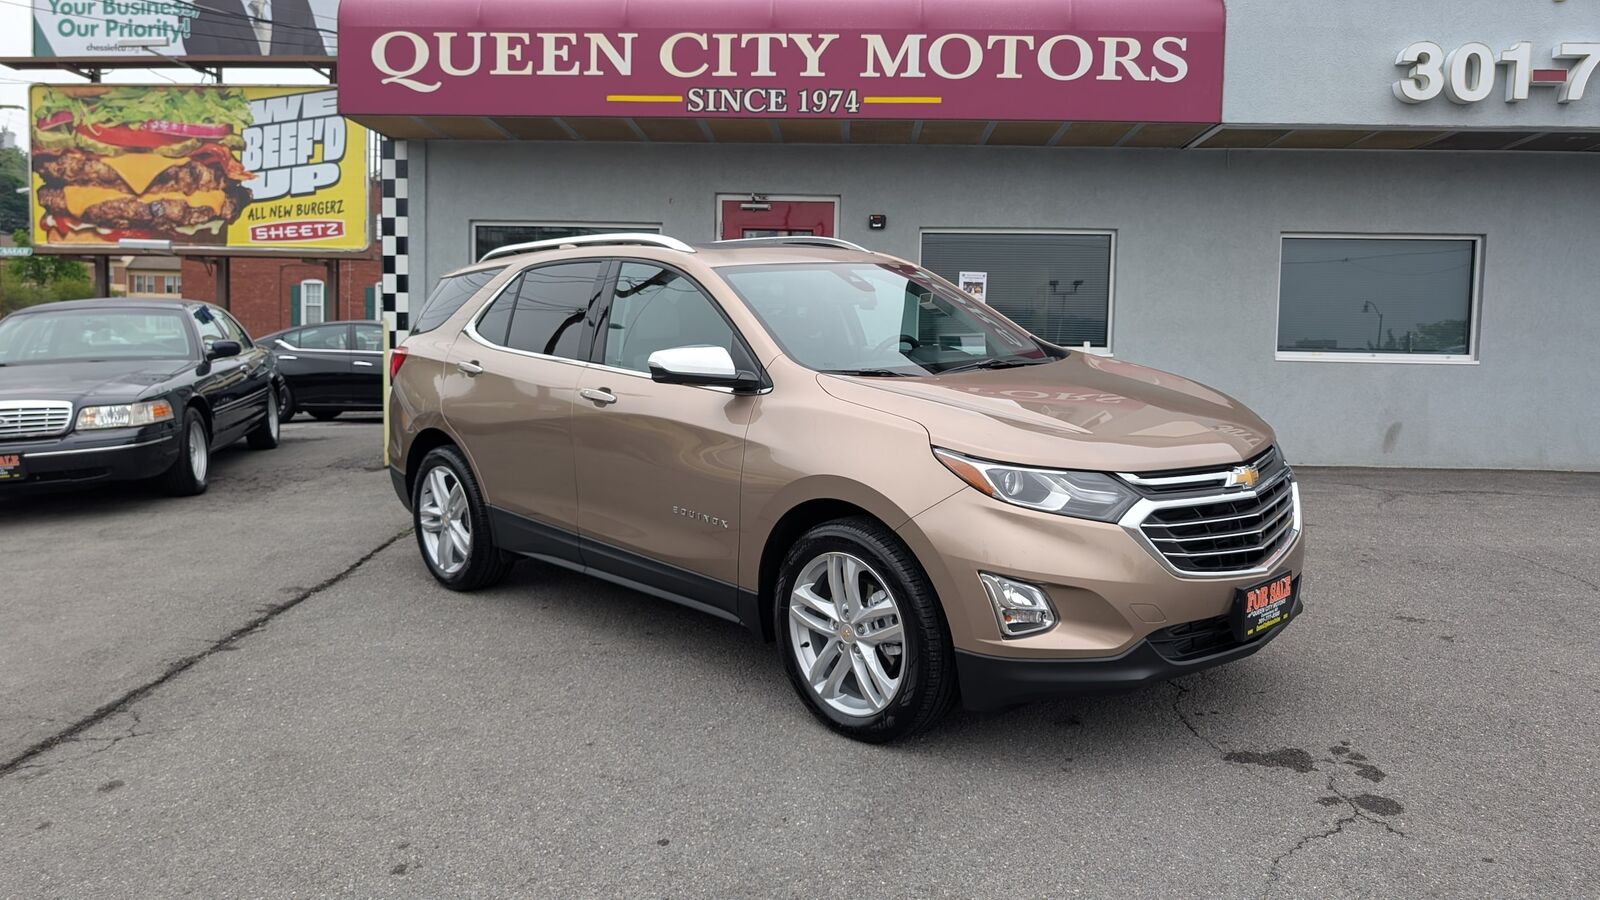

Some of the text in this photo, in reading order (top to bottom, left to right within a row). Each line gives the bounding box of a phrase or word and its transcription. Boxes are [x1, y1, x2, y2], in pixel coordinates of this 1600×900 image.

[50, 0, 97, 15] Your
[57, 17, 191, 43] Our Priority!
[371, 31, 1189, 93] QUEEN CITY MOTORS
[1392, 41, 1600, 104] 301-7
[249, 89, 338, 125] WE
[686, 87, 860, 114] SINCE 1974
[242, 115, 346, 172] BEEF'D
[241, 162, 341, 200] UP
[248, 200, 345, 220] ALL NEW BURGERZ
[255, 222, 339, 240] SHEETZ
[672, 505, 729, 529] EQUINOX
[1246, 586, 1268, 613] FOR
[1269, 575, 1291, 604] SALE
